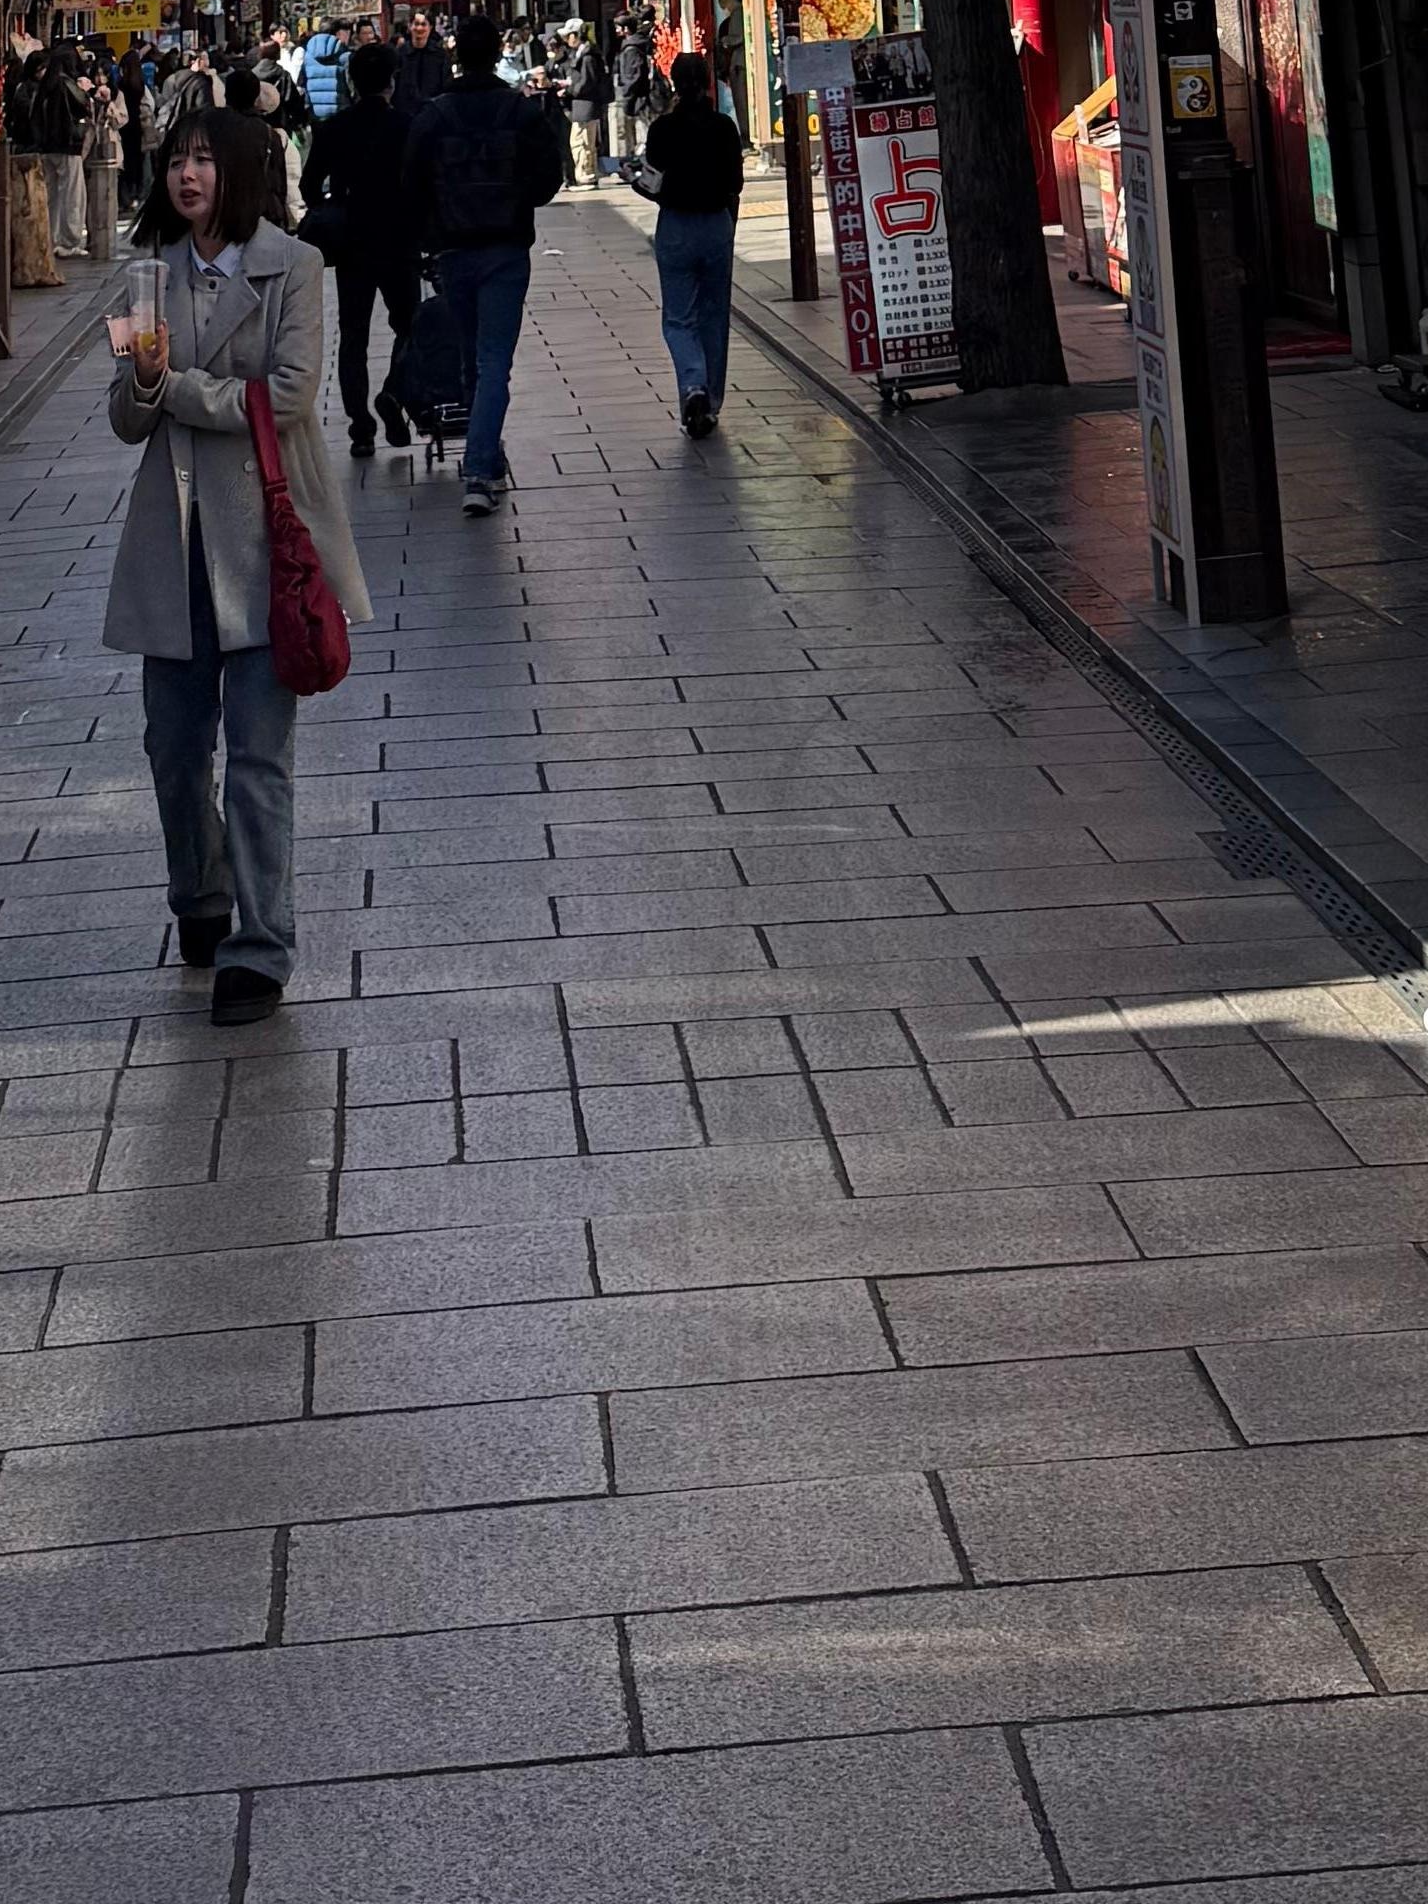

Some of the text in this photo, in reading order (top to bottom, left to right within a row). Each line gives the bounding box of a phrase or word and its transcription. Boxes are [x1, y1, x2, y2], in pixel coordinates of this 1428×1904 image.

[825, 86, 867, 267] 中華街で的中率
[871, 136, 943, 240] 占
